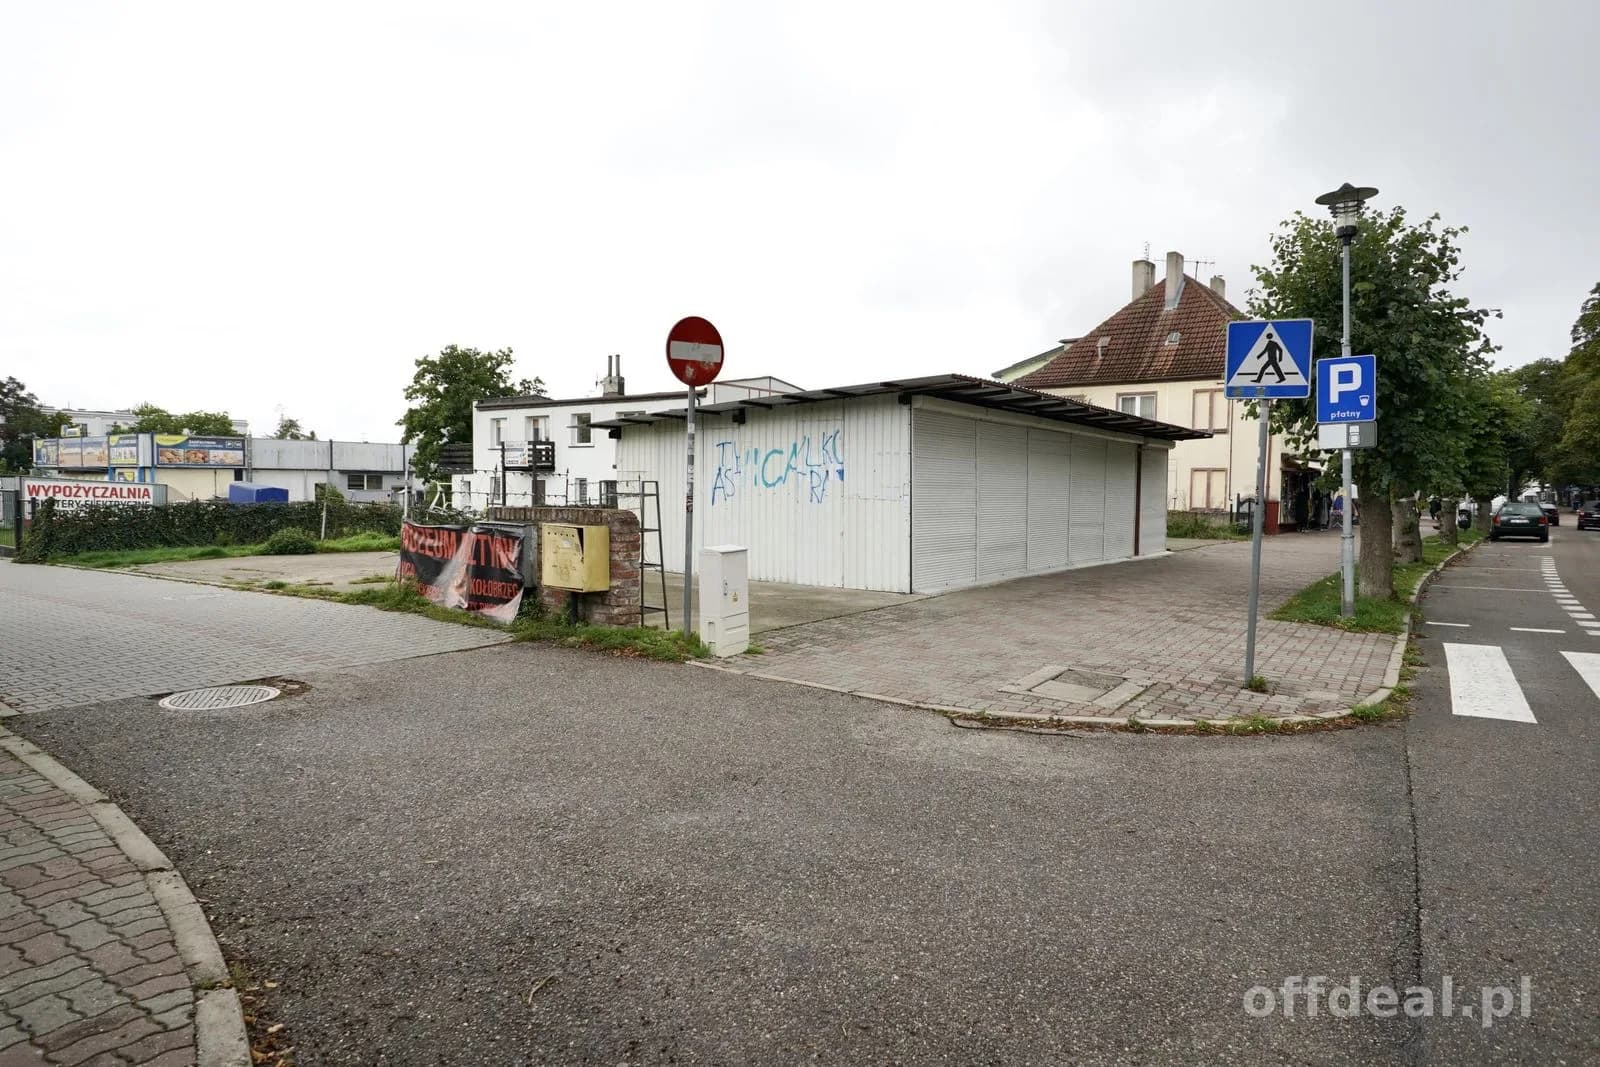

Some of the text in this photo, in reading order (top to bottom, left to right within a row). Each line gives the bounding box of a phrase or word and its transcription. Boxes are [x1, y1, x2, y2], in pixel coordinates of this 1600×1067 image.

[1329, 362, 1362, 404] P
[1330, 410, 1361, 420] płatny
[27, 484, 151, 499] WYPOŻYCZALNIA
